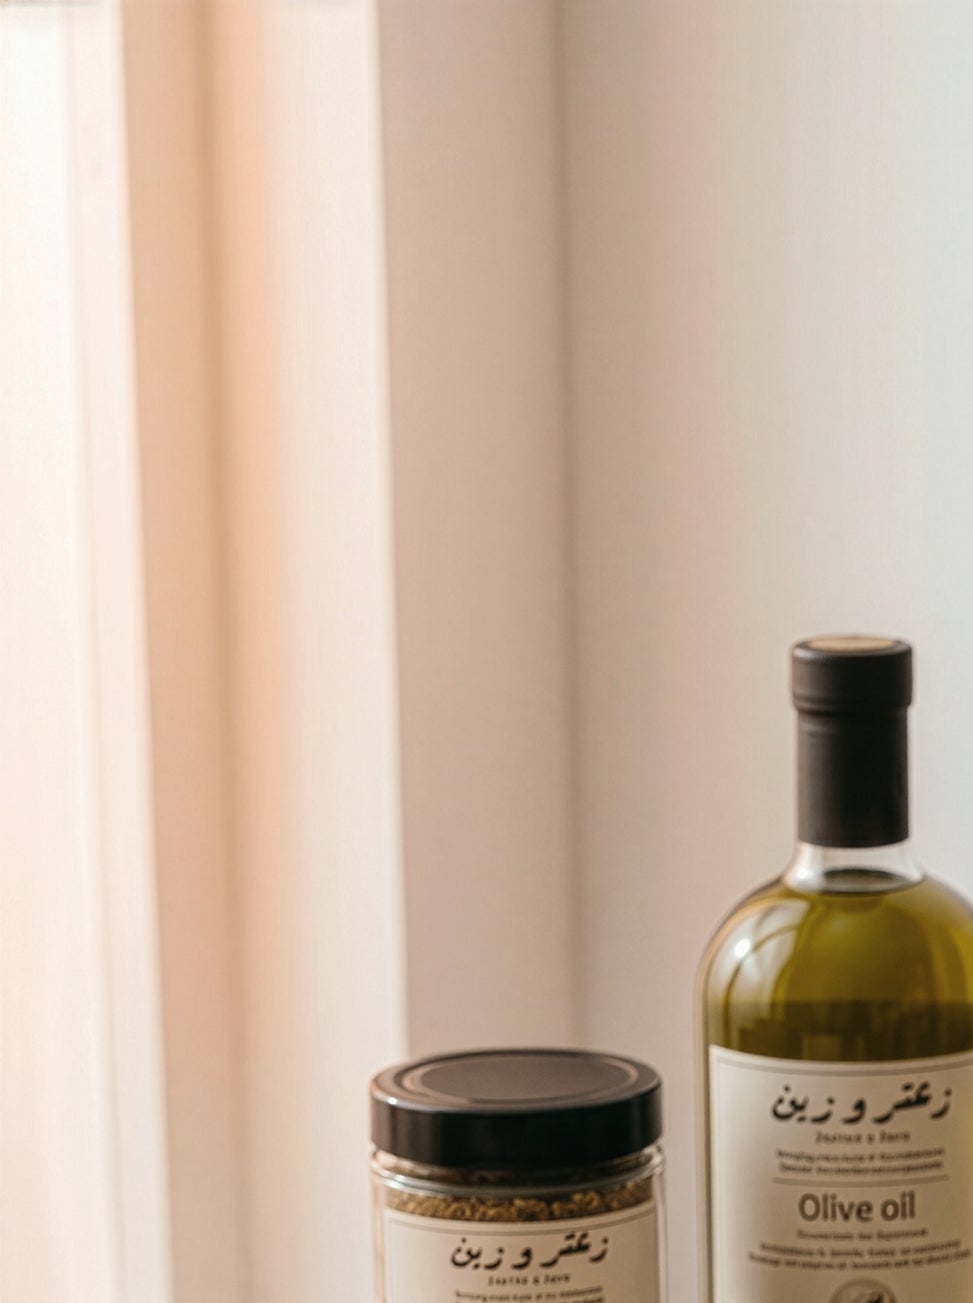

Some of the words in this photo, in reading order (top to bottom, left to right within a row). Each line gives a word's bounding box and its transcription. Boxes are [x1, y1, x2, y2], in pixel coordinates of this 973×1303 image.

[842, 1098, 867, 1124] و
[798, 1192, 874, 1222] Olive
[881, 1190, 916, 1221] oil
[511, 1245, 533, 1270] و
